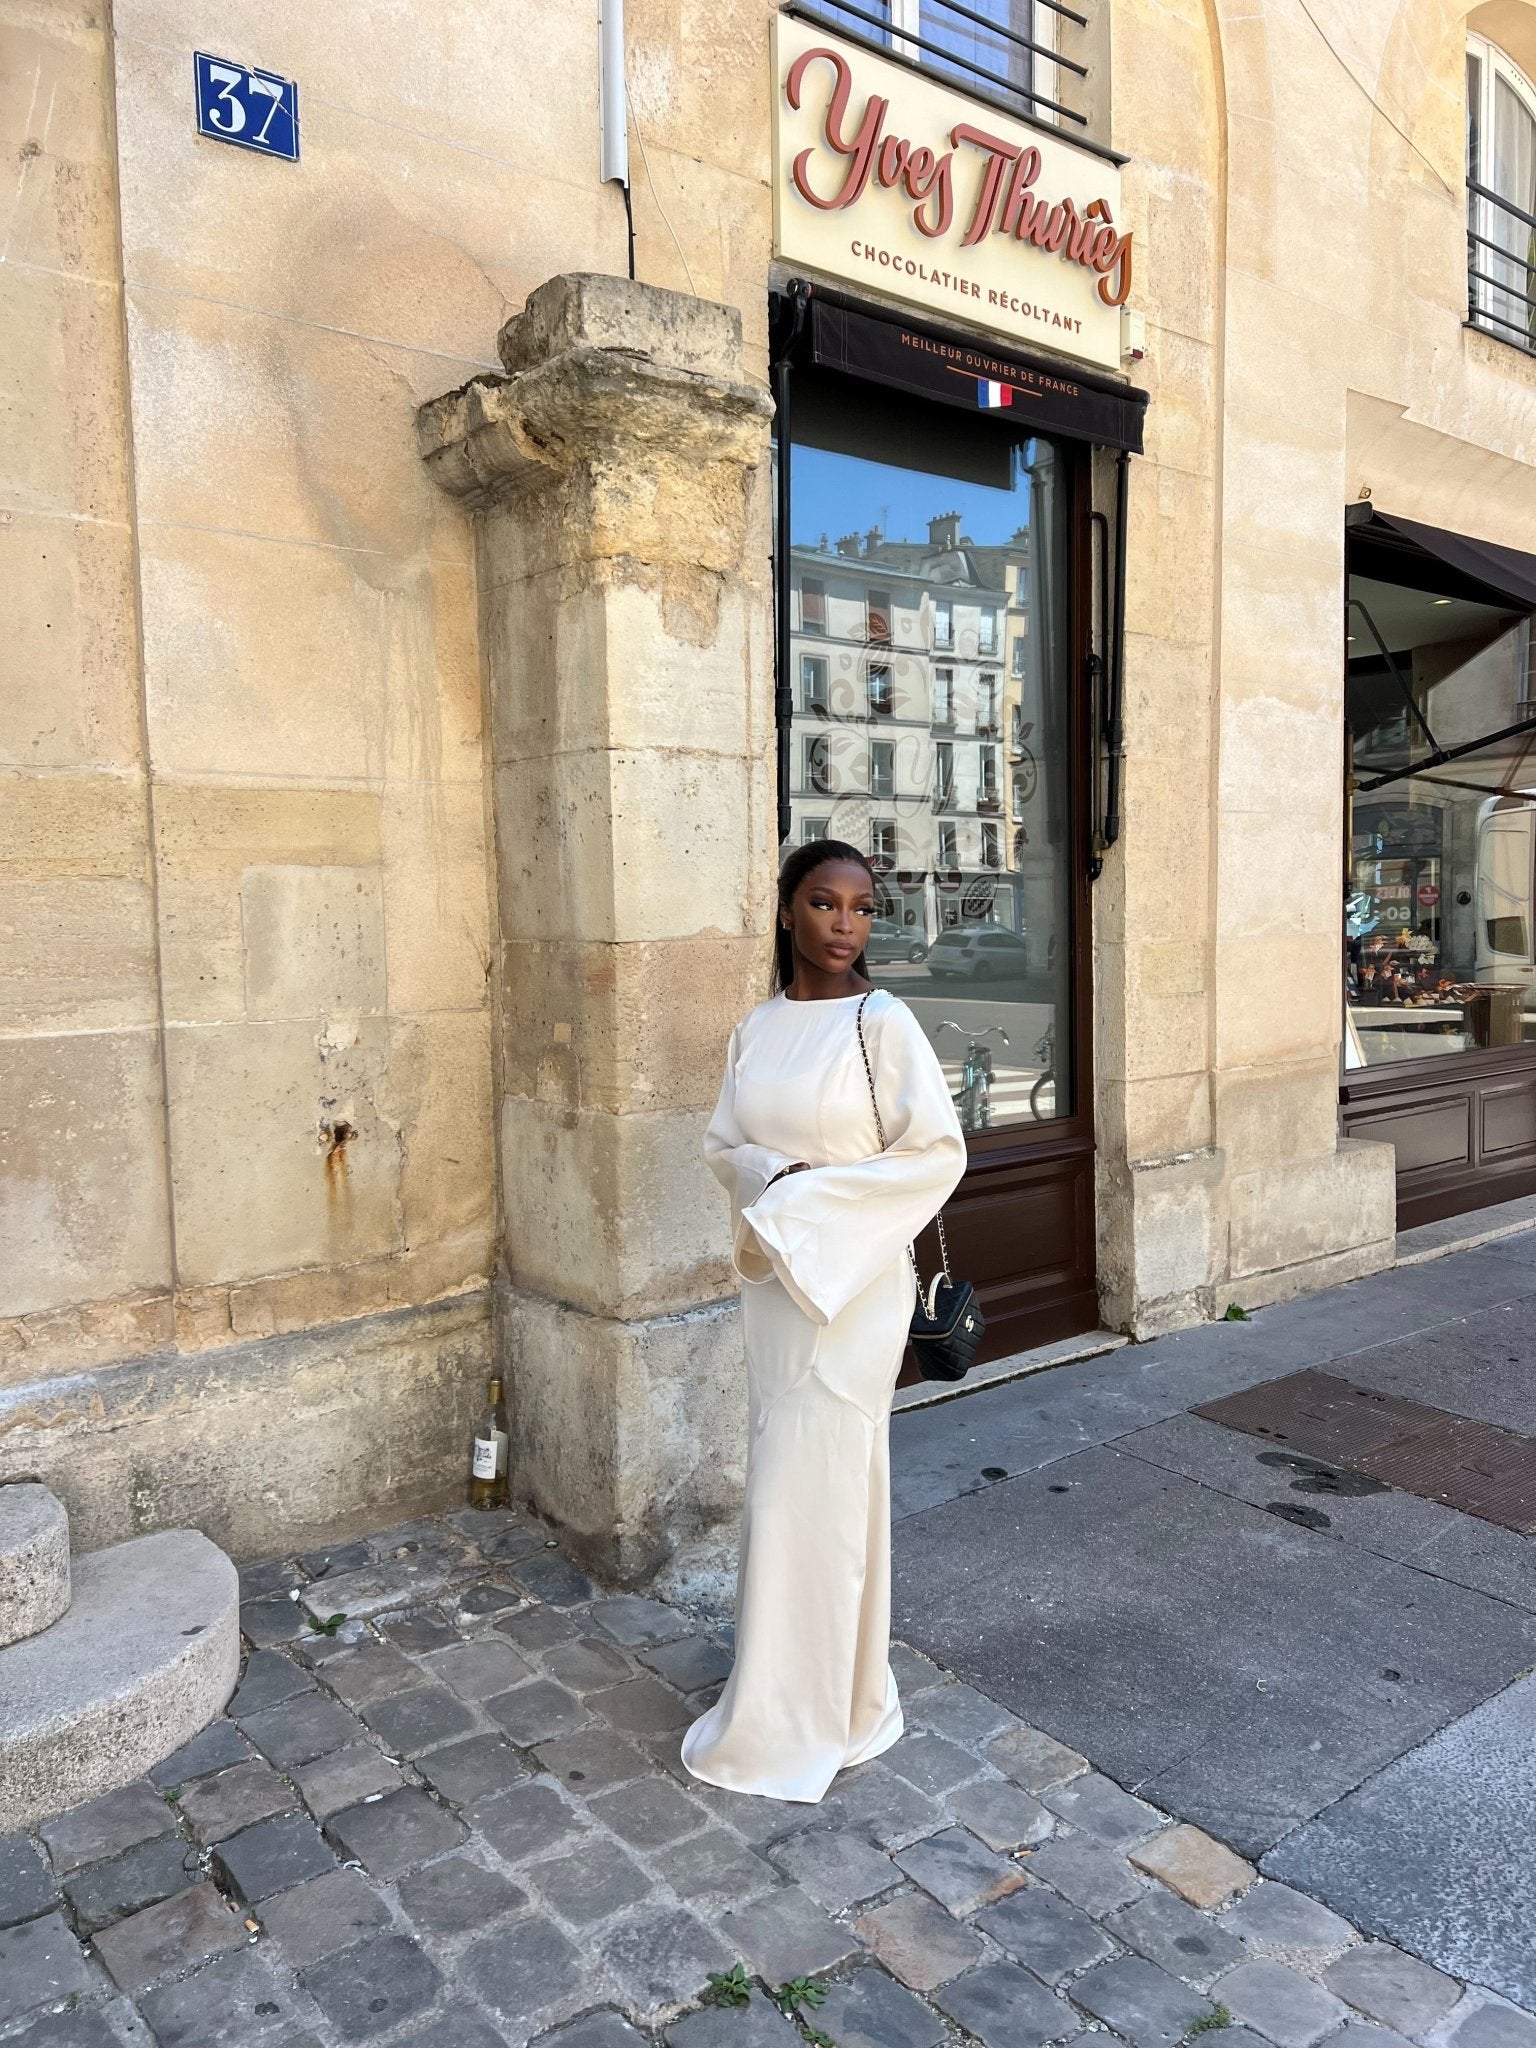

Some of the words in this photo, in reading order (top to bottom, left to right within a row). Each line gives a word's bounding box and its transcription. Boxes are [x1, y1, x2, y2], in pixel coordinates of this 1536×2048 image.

[208, 64, 284, 144] 37
[786, 47, 954, 238] Yves
[950, 122, 1134, 306] Thuriès
[851, 240, 981, 299] CHOCOLATIER
[988, 290, 1083, 334] RÉCOLTANT
[901, 333, 962, 361] MEILLEUR
[966, 354, 1017, 378] OUVRIER
[1020, 370, 1034, 383] DE
[1038, 376, 1079, 397] FRANCE
